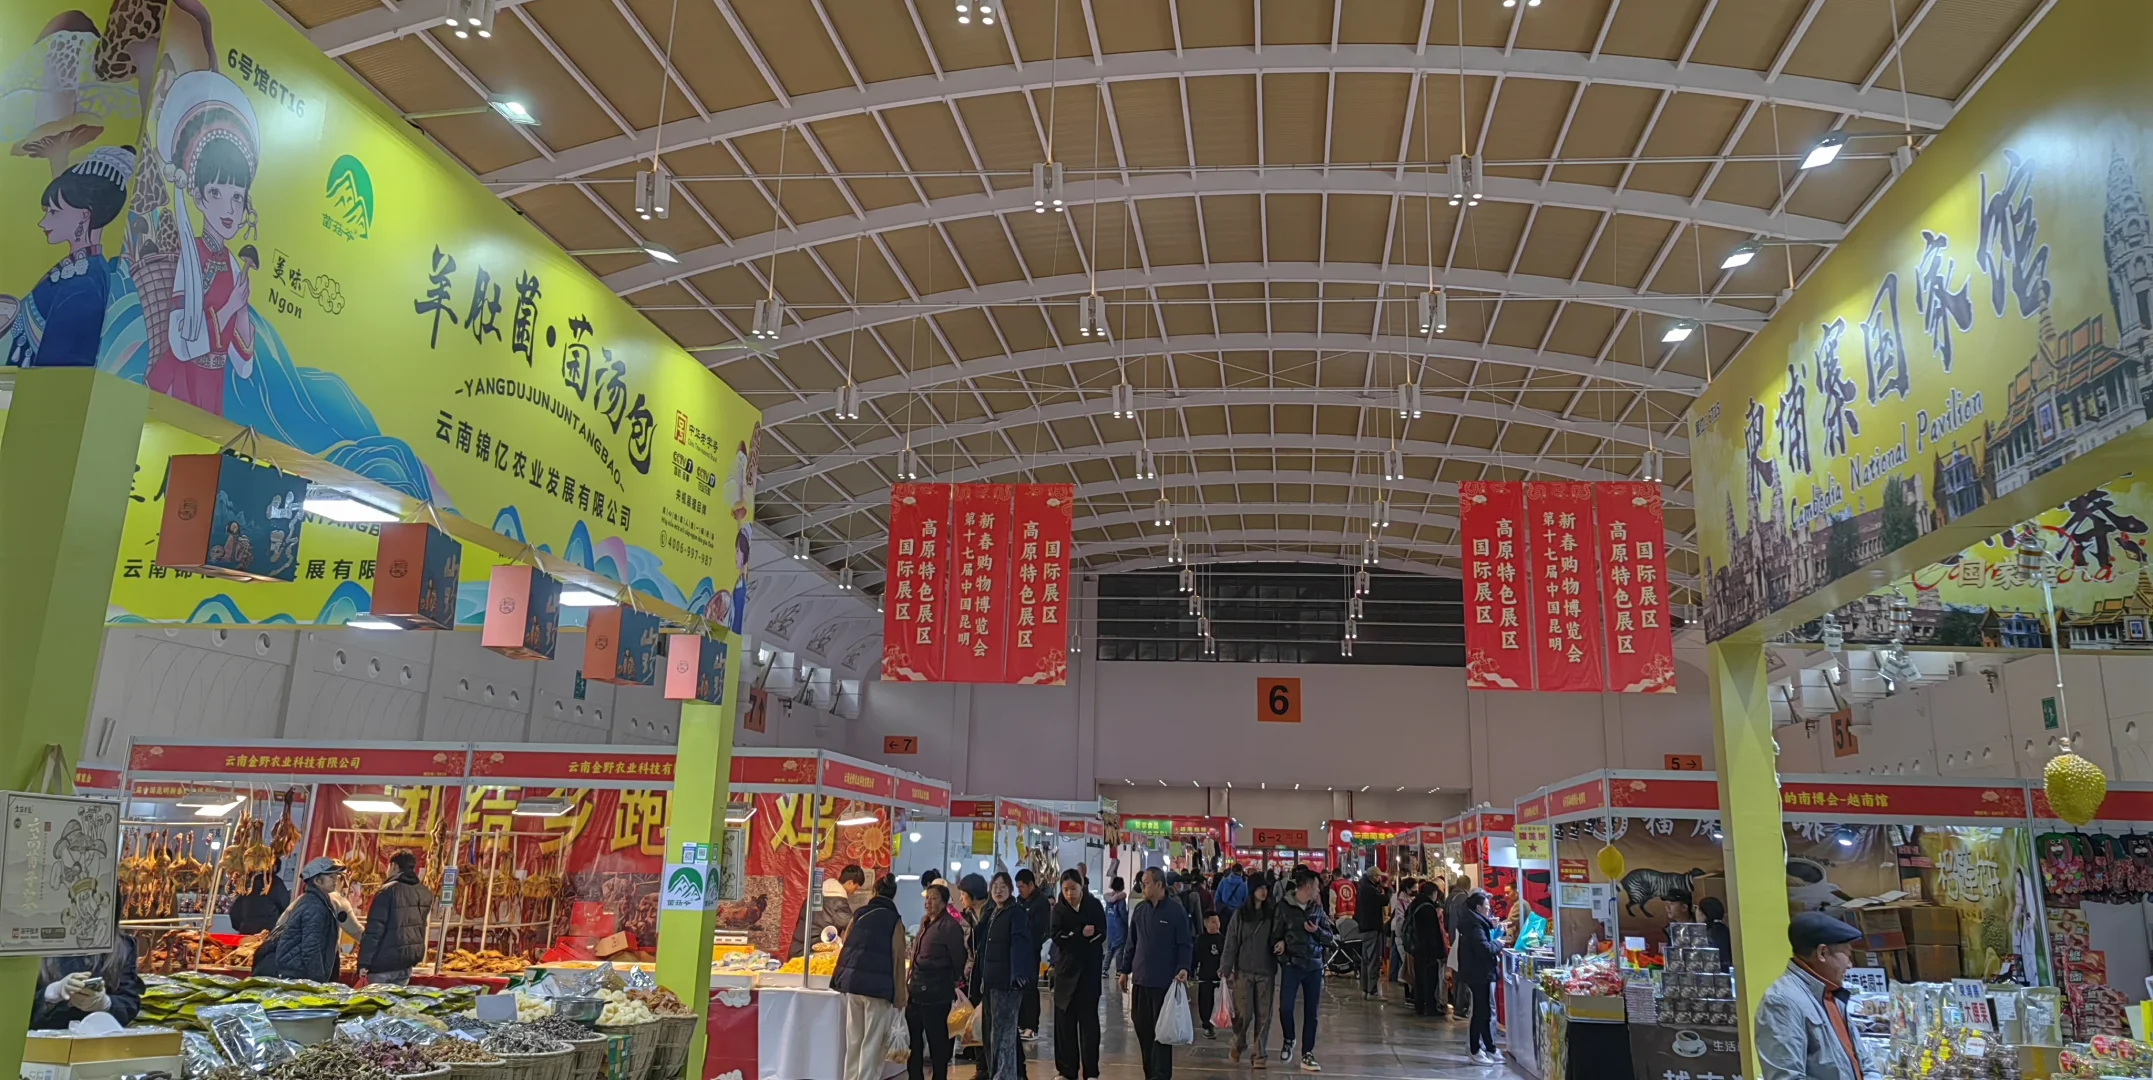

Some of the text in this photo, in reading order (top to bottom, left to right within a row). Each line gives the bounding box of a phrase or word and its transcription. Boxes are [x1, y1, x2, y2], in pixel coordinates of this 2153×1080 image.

[228, 48, 305, 119] 6号馆6T16
[268, 288, 303, 319] Ngon
[1744, 149, 2050, 502] 柬埔寨国家馆
[435, 410, 631, 532] 云南锦亿农业发展有限公司
[1791, 388, 1984, 530] Cambodia National Pavilion
[895, 538, 914, 621] 国际展区
[916, 518, 938, 645] 高原特色展区
[957, 511, 976, 647] 第十七届中国昆明
[972, 512, 996, 657] 新春购物博览会
[1017, 520, 1040, 648] 高原特色展区
[1041, 540, 1061, 624] 国际展区
[1472, 538, 1494, 624] 国际展区
[1496, 517, 1520, 650] 高原特色展区
[1543, 511, 1563, 652] 第十七届中国昆明
[1558, 511, 1583, 663] 新春购物博览会
[1609, 520, 1635, 654] 高原特色展区
[1635, 541, 1660, 629] 国际展区
[1269, 685, 1289, 716] 6
[225, 755, 361, 769] 云南金野农业科技有限公司
[568, 760, 676, 776] 云南金野农业科技有
[903, 739, 913, 752] 7
[1670, 756, 1680, 770] 5
[1784, 790, 1890, 808] 的南博会-越南馆
[1713, 1040, 1741, 1052] 生活
